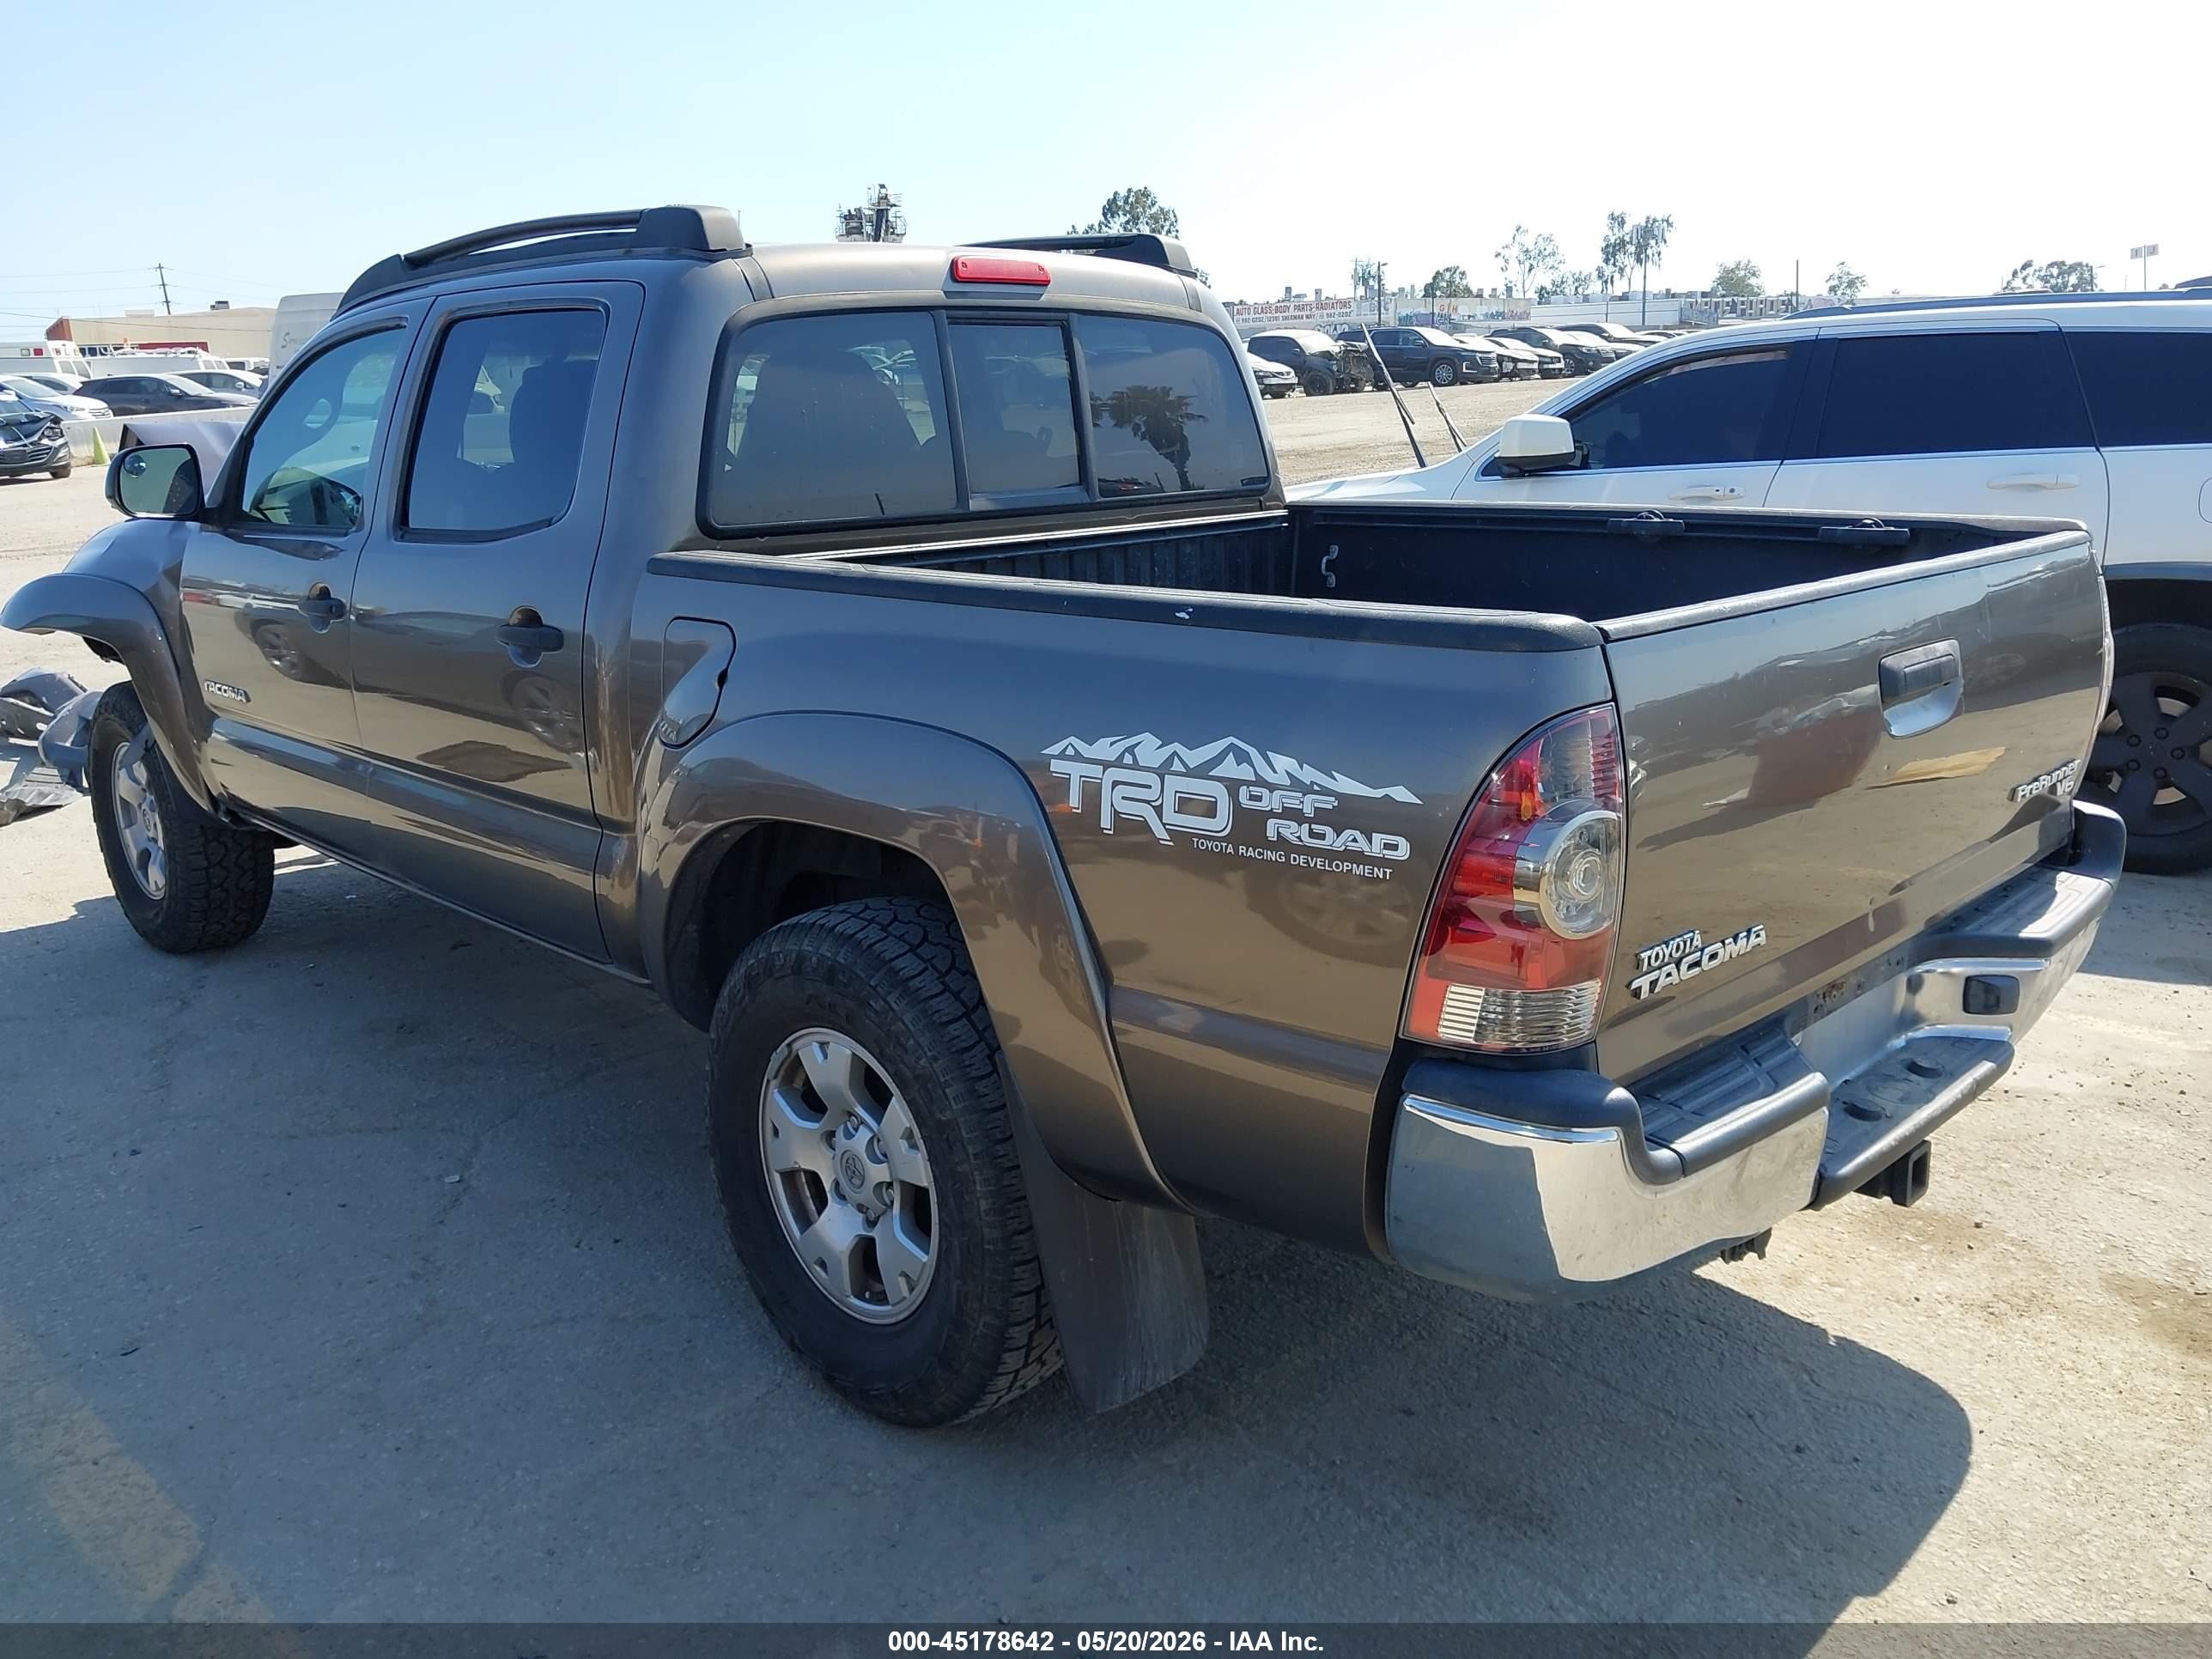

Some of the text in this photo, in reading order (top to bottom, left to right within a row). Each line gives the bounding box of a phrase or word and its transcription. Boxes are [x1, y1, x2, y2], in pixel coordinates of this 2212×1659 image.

[1236, 307, 1251, 316] AUTO
[1281, 313, 1304, 322] SHERMAN
[204, 680, 247, 703] TACOMA
[1049, 758, 1233, 847] TRD
[1238, 785, 1339, 817] OFF
[2017, 759, 2081, 803] PreRunner
[2056, 775, 2075, 797] V6
[1191, 837, 1393, 880] TOYOTA RACING DEVELOPMENT
[1266, 817, 1411, 861] ROAD
[1629, 923, 1766, 1000] TACOMA
[1638, 929, 1703, 973] TOYOTA
